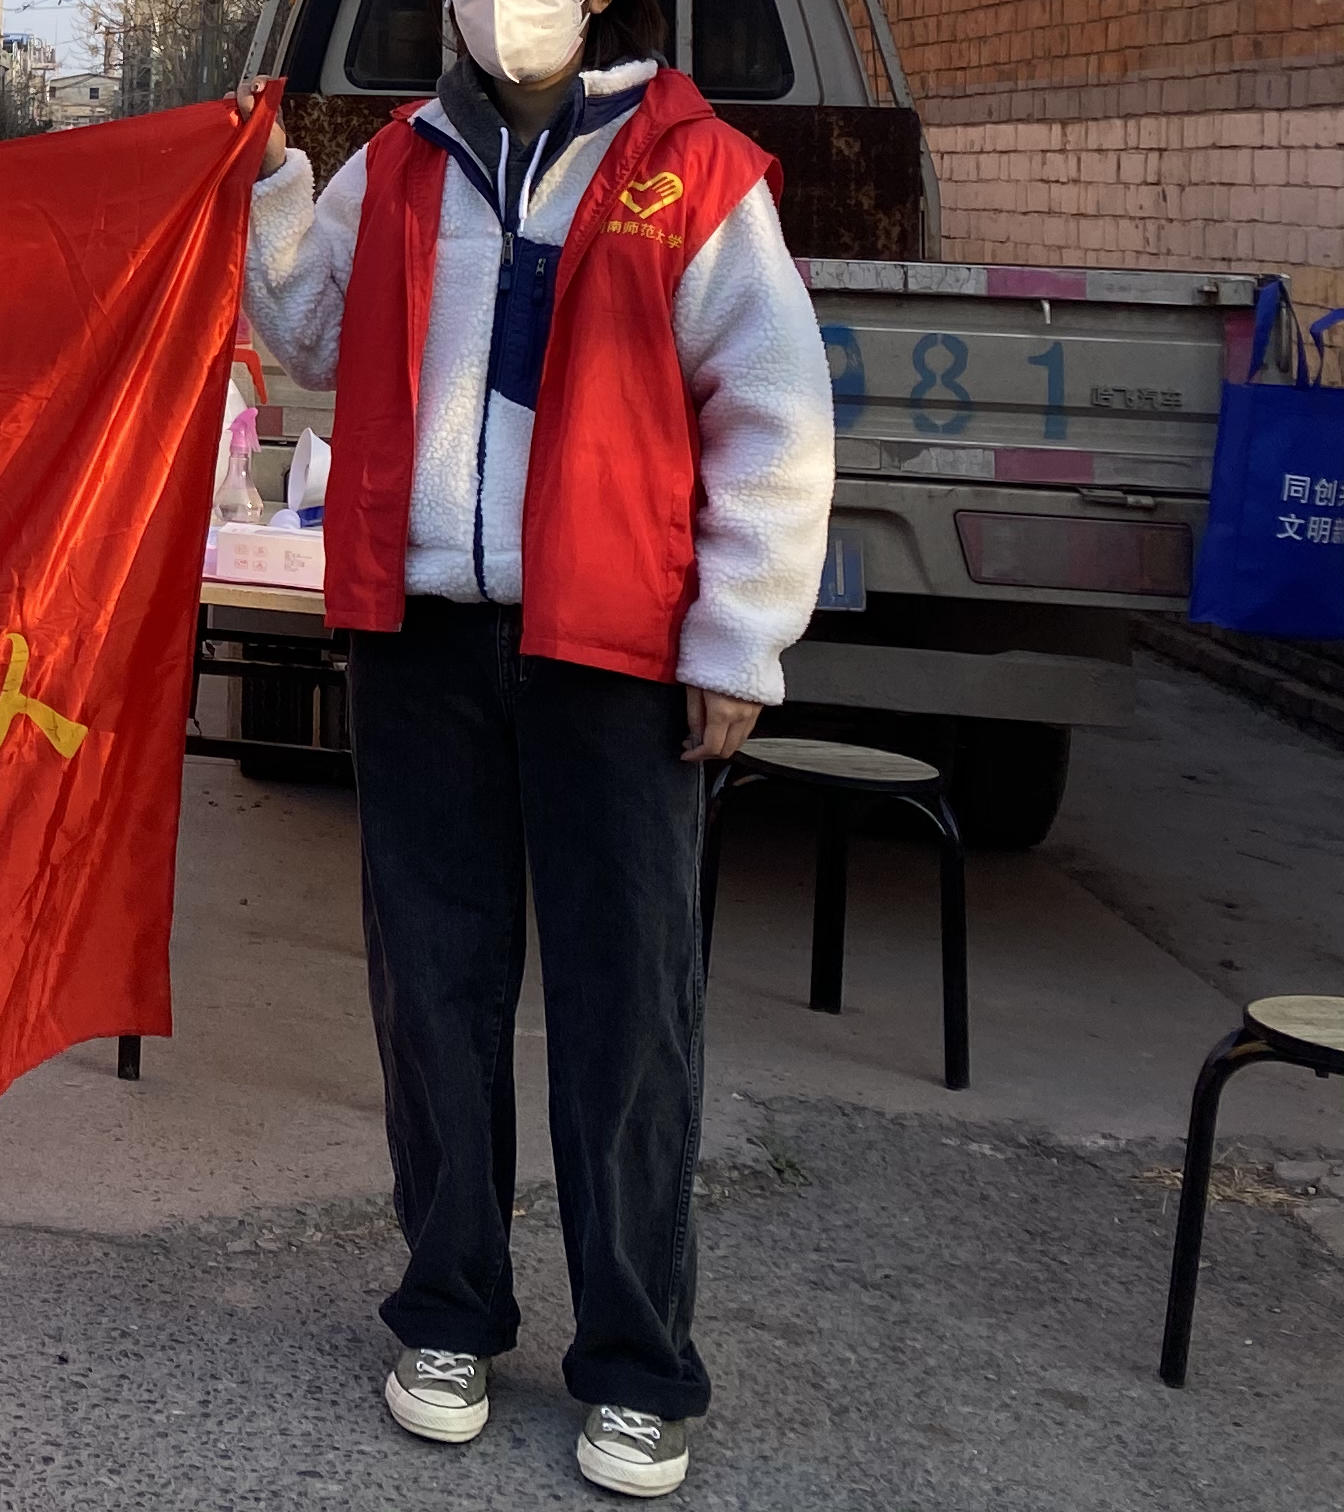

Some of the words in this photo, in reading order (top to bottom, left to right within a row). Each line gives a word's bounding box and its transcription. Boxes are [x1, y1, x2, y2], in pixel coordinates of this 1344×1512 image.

[600, 220, 683, 248] 南师范大学
